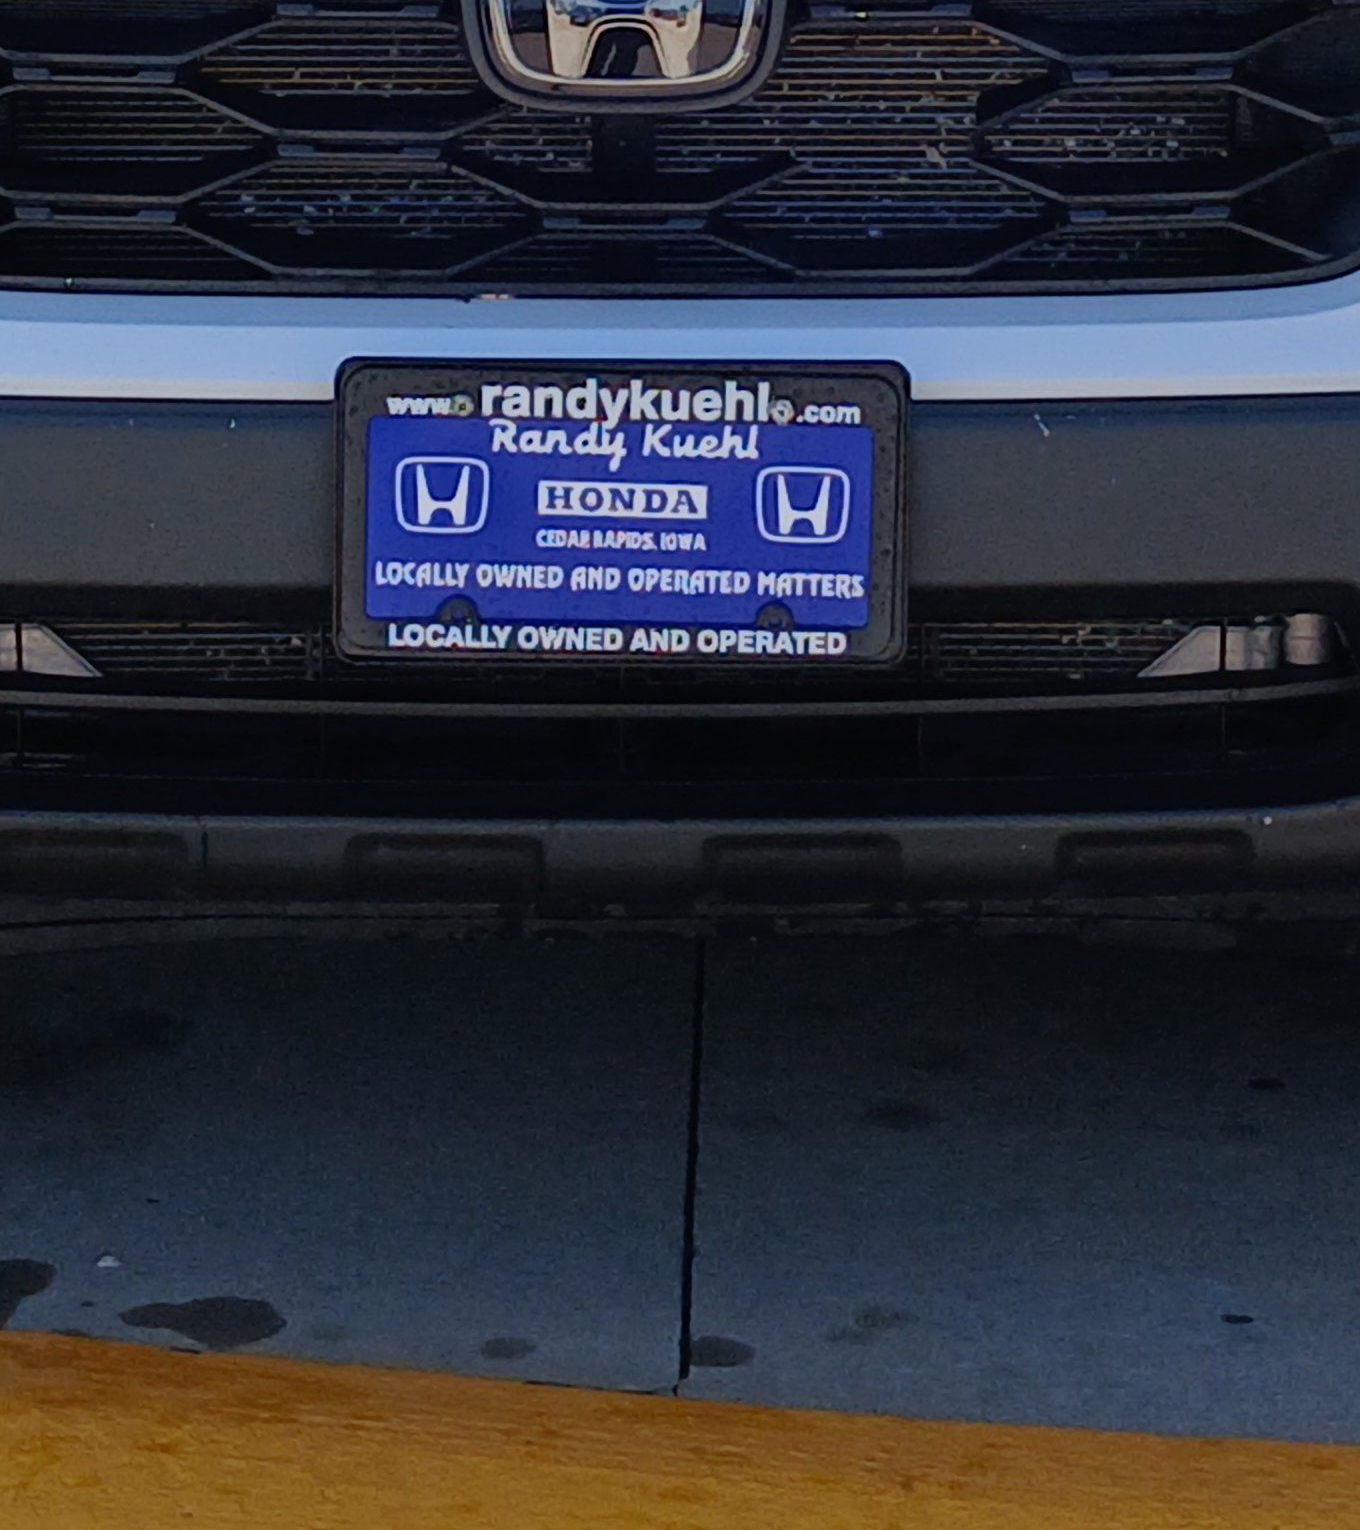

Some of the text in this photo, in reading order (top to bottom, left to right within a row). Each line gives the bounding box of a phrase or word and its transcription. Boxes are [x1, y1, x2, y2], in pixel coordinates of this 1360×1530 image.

[489, 419, 759, 472] Randy Kuehl
[545, 486, 699, 514] HONDA
[536, 528, 590, 550] CEDAR
[660, 532, 707, 551] IOWA
[375, 560, 866, 599] LOCALLY OWNED AND OPERATED MATTERS
[388, 622, 848, 655] LOCALLY OWNED AND OPERATED
